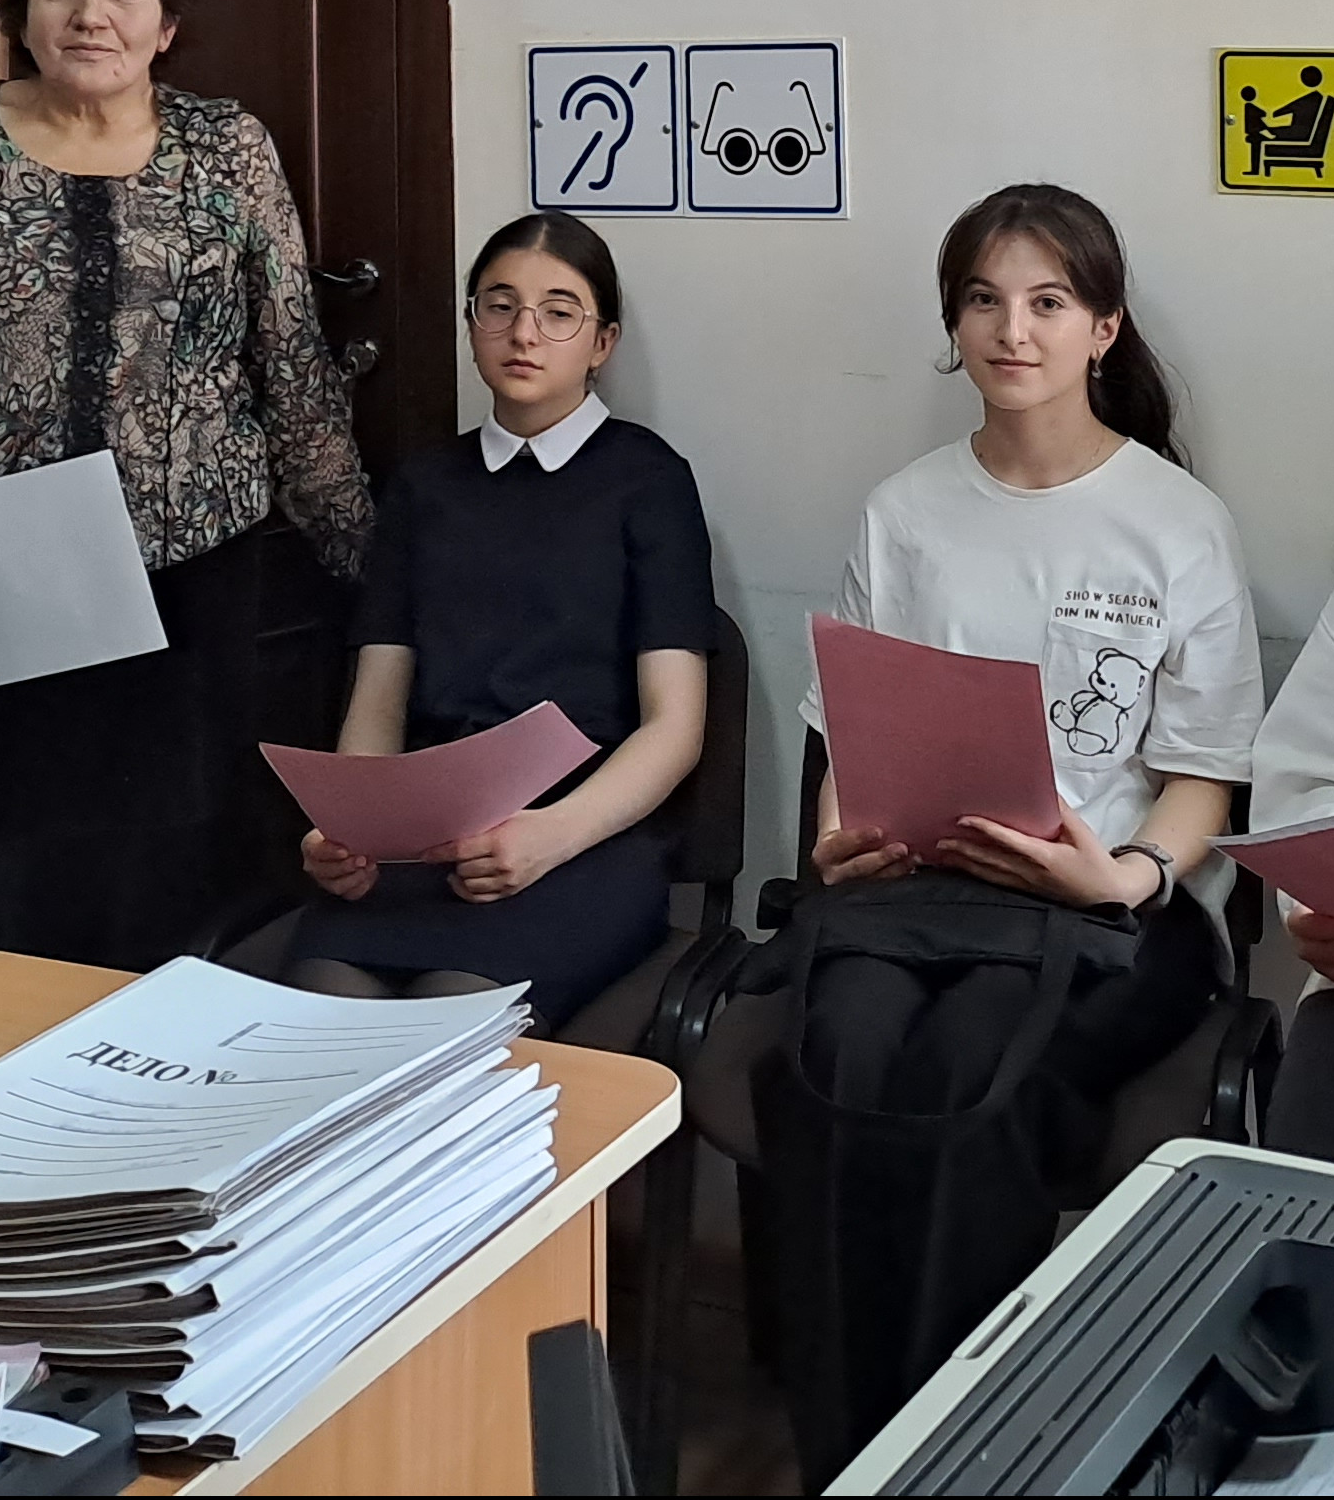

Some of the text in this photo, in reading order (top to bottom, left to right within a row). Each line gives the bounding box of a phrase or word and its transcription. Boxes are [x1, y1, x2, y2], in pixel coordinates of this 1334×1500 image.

[1107, 593, 1159, 611] SEASON
[1084, 608, 1100, 620] IN
[66, 1041, 192, 1082] ДЕЛО
